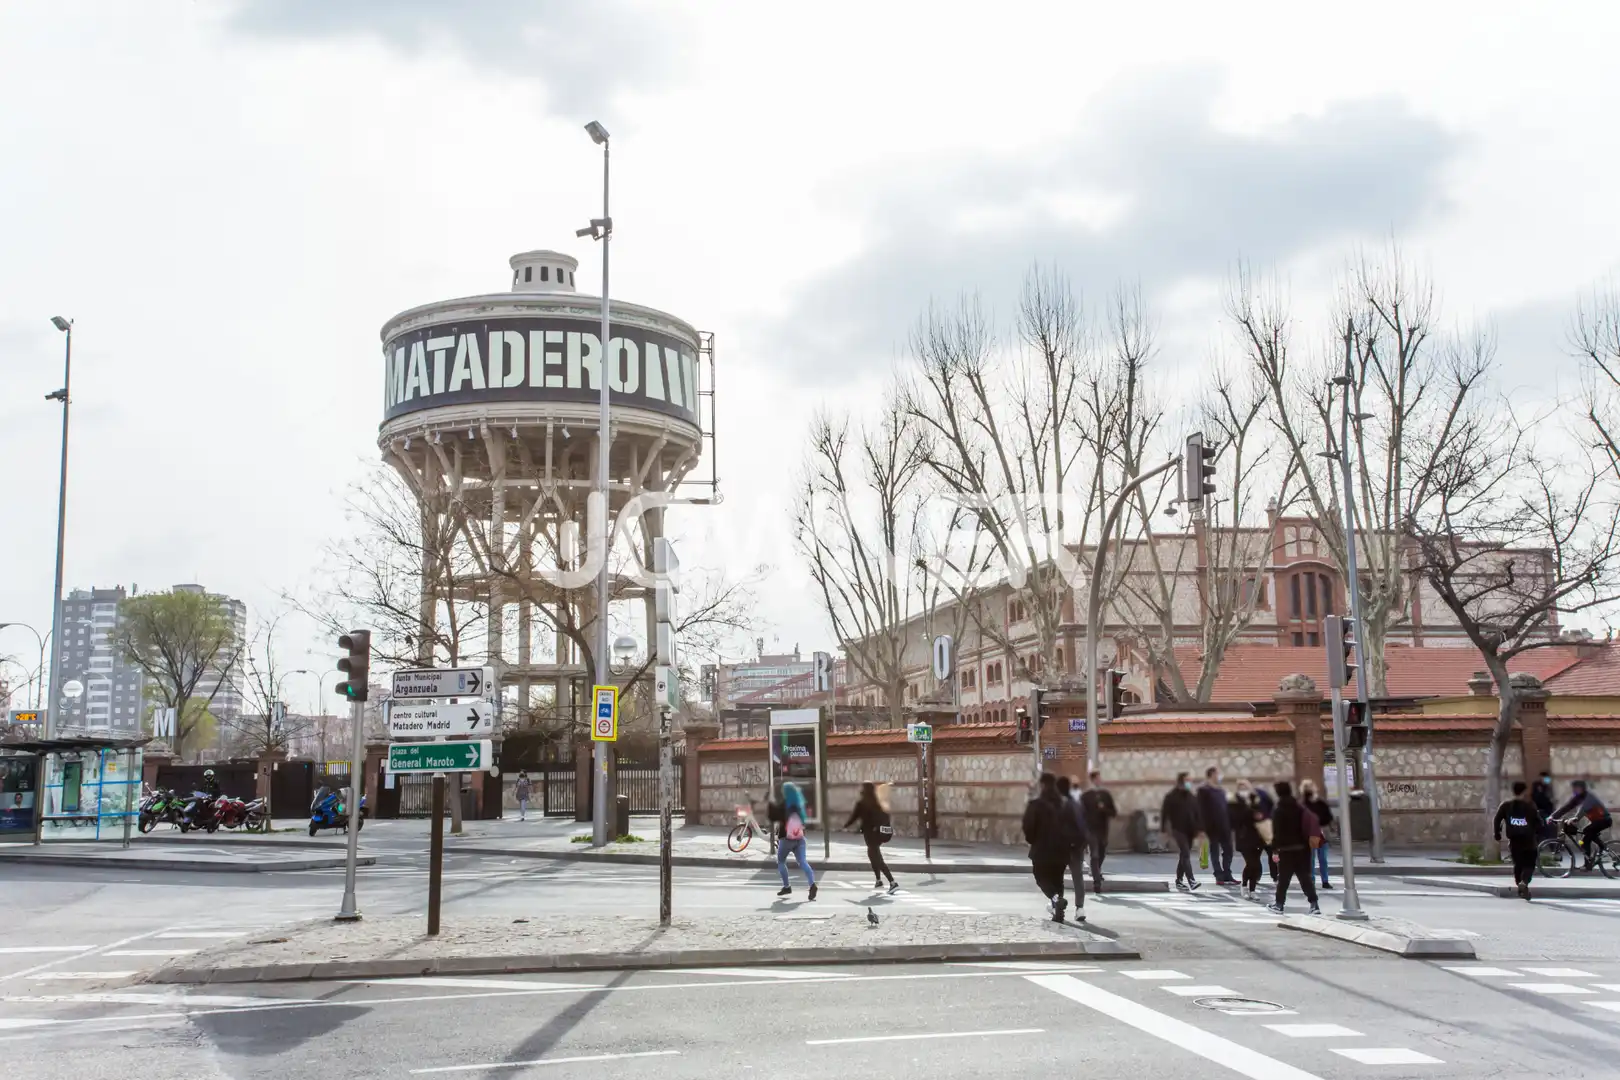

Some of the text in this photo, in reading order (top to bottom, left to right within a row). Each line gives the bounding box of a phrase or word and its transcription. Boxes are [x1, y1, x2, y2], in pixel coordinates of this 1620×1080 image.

[395, 672, 443, 682] Junta Municipal
[395, 683, 438, 695] Arganzuela
[393, 710, 438, 719] centro cultural
[392, 720, 451, 730] Matadero Madrid
[391, 746, 419, 757] plaza del
[790, 751, 810, 759] parada
[391, 756, 455, 769] General Maroto
